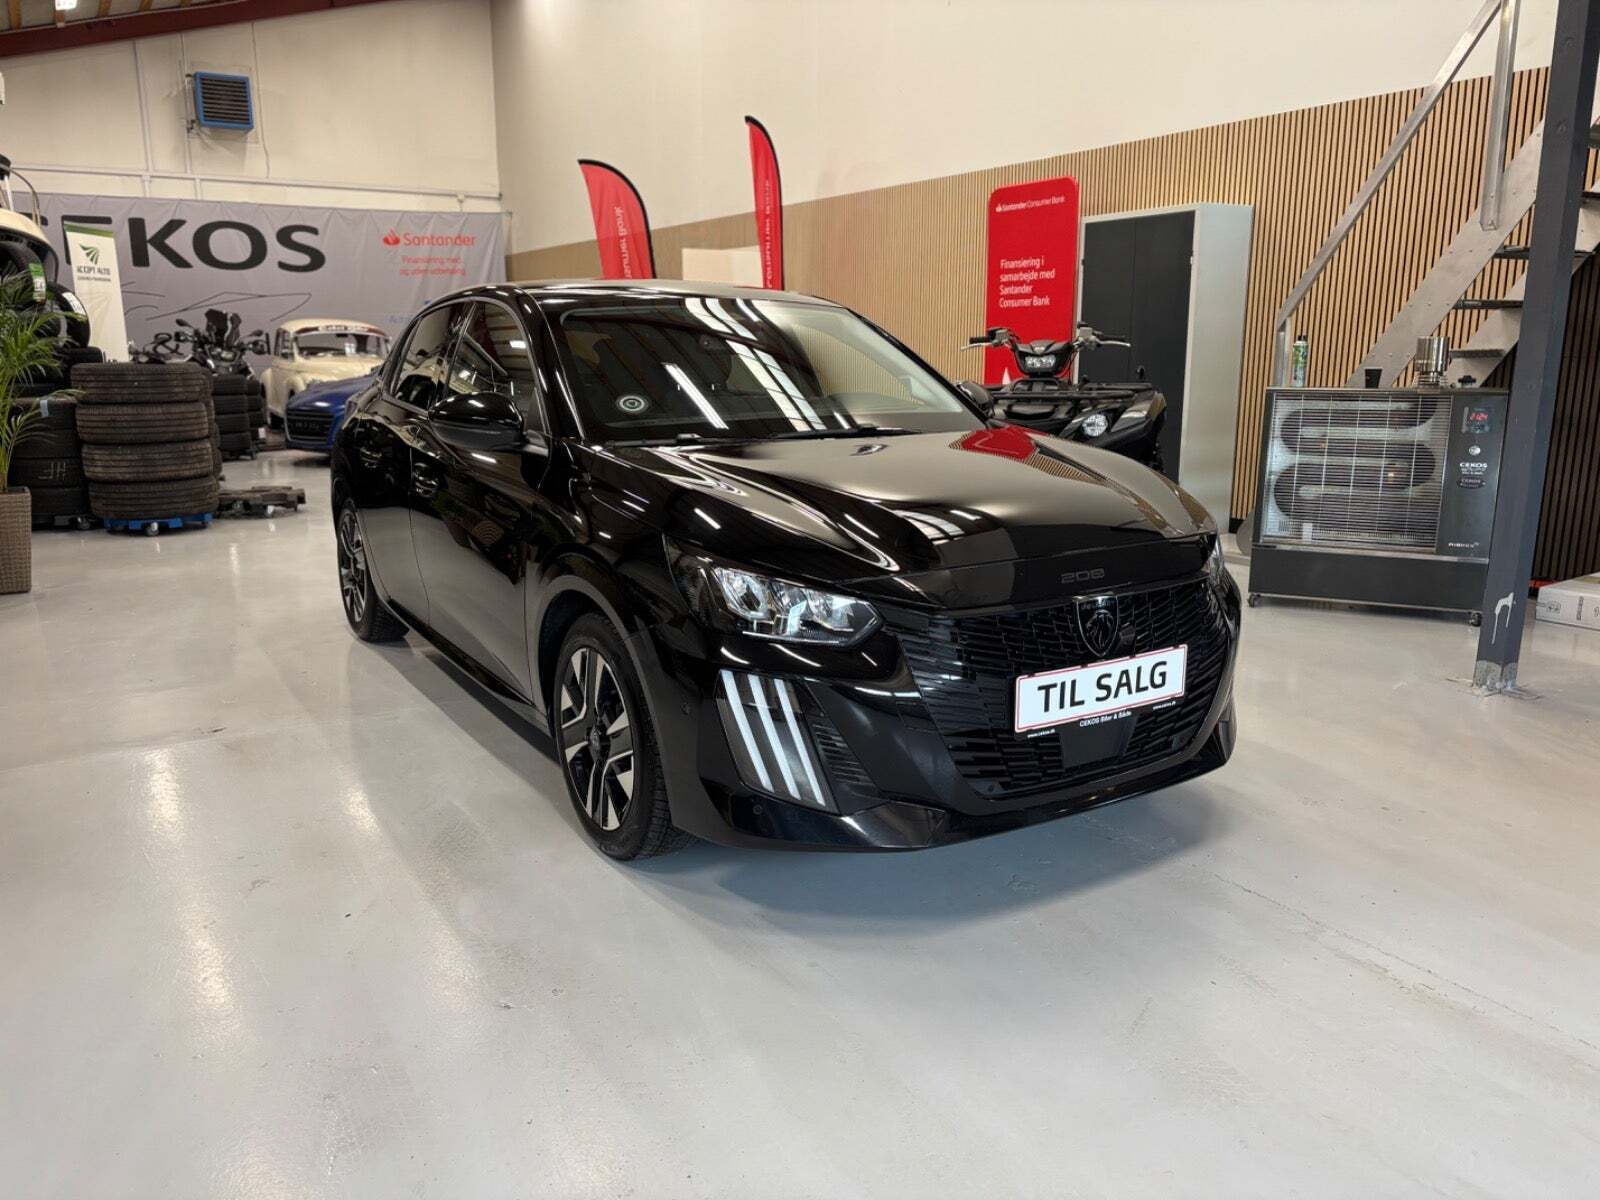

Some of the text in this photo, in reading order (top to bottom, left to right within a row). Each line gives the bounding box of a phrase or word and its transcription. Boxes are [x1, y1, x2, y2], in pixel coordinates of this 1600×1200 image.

[403, 232, 476, 246] Santander
[1000, 257, 1040, 269] Finansiering
[1000, 268, 1056, 283] samarbejde med
[1000, 284, 1033, 295] Santander
[1000, 295, 1050, 308] Consumer Bank
[1061, 568, 1105, 584] 208
[1037, 661, 1167, 713] TIL SALG
